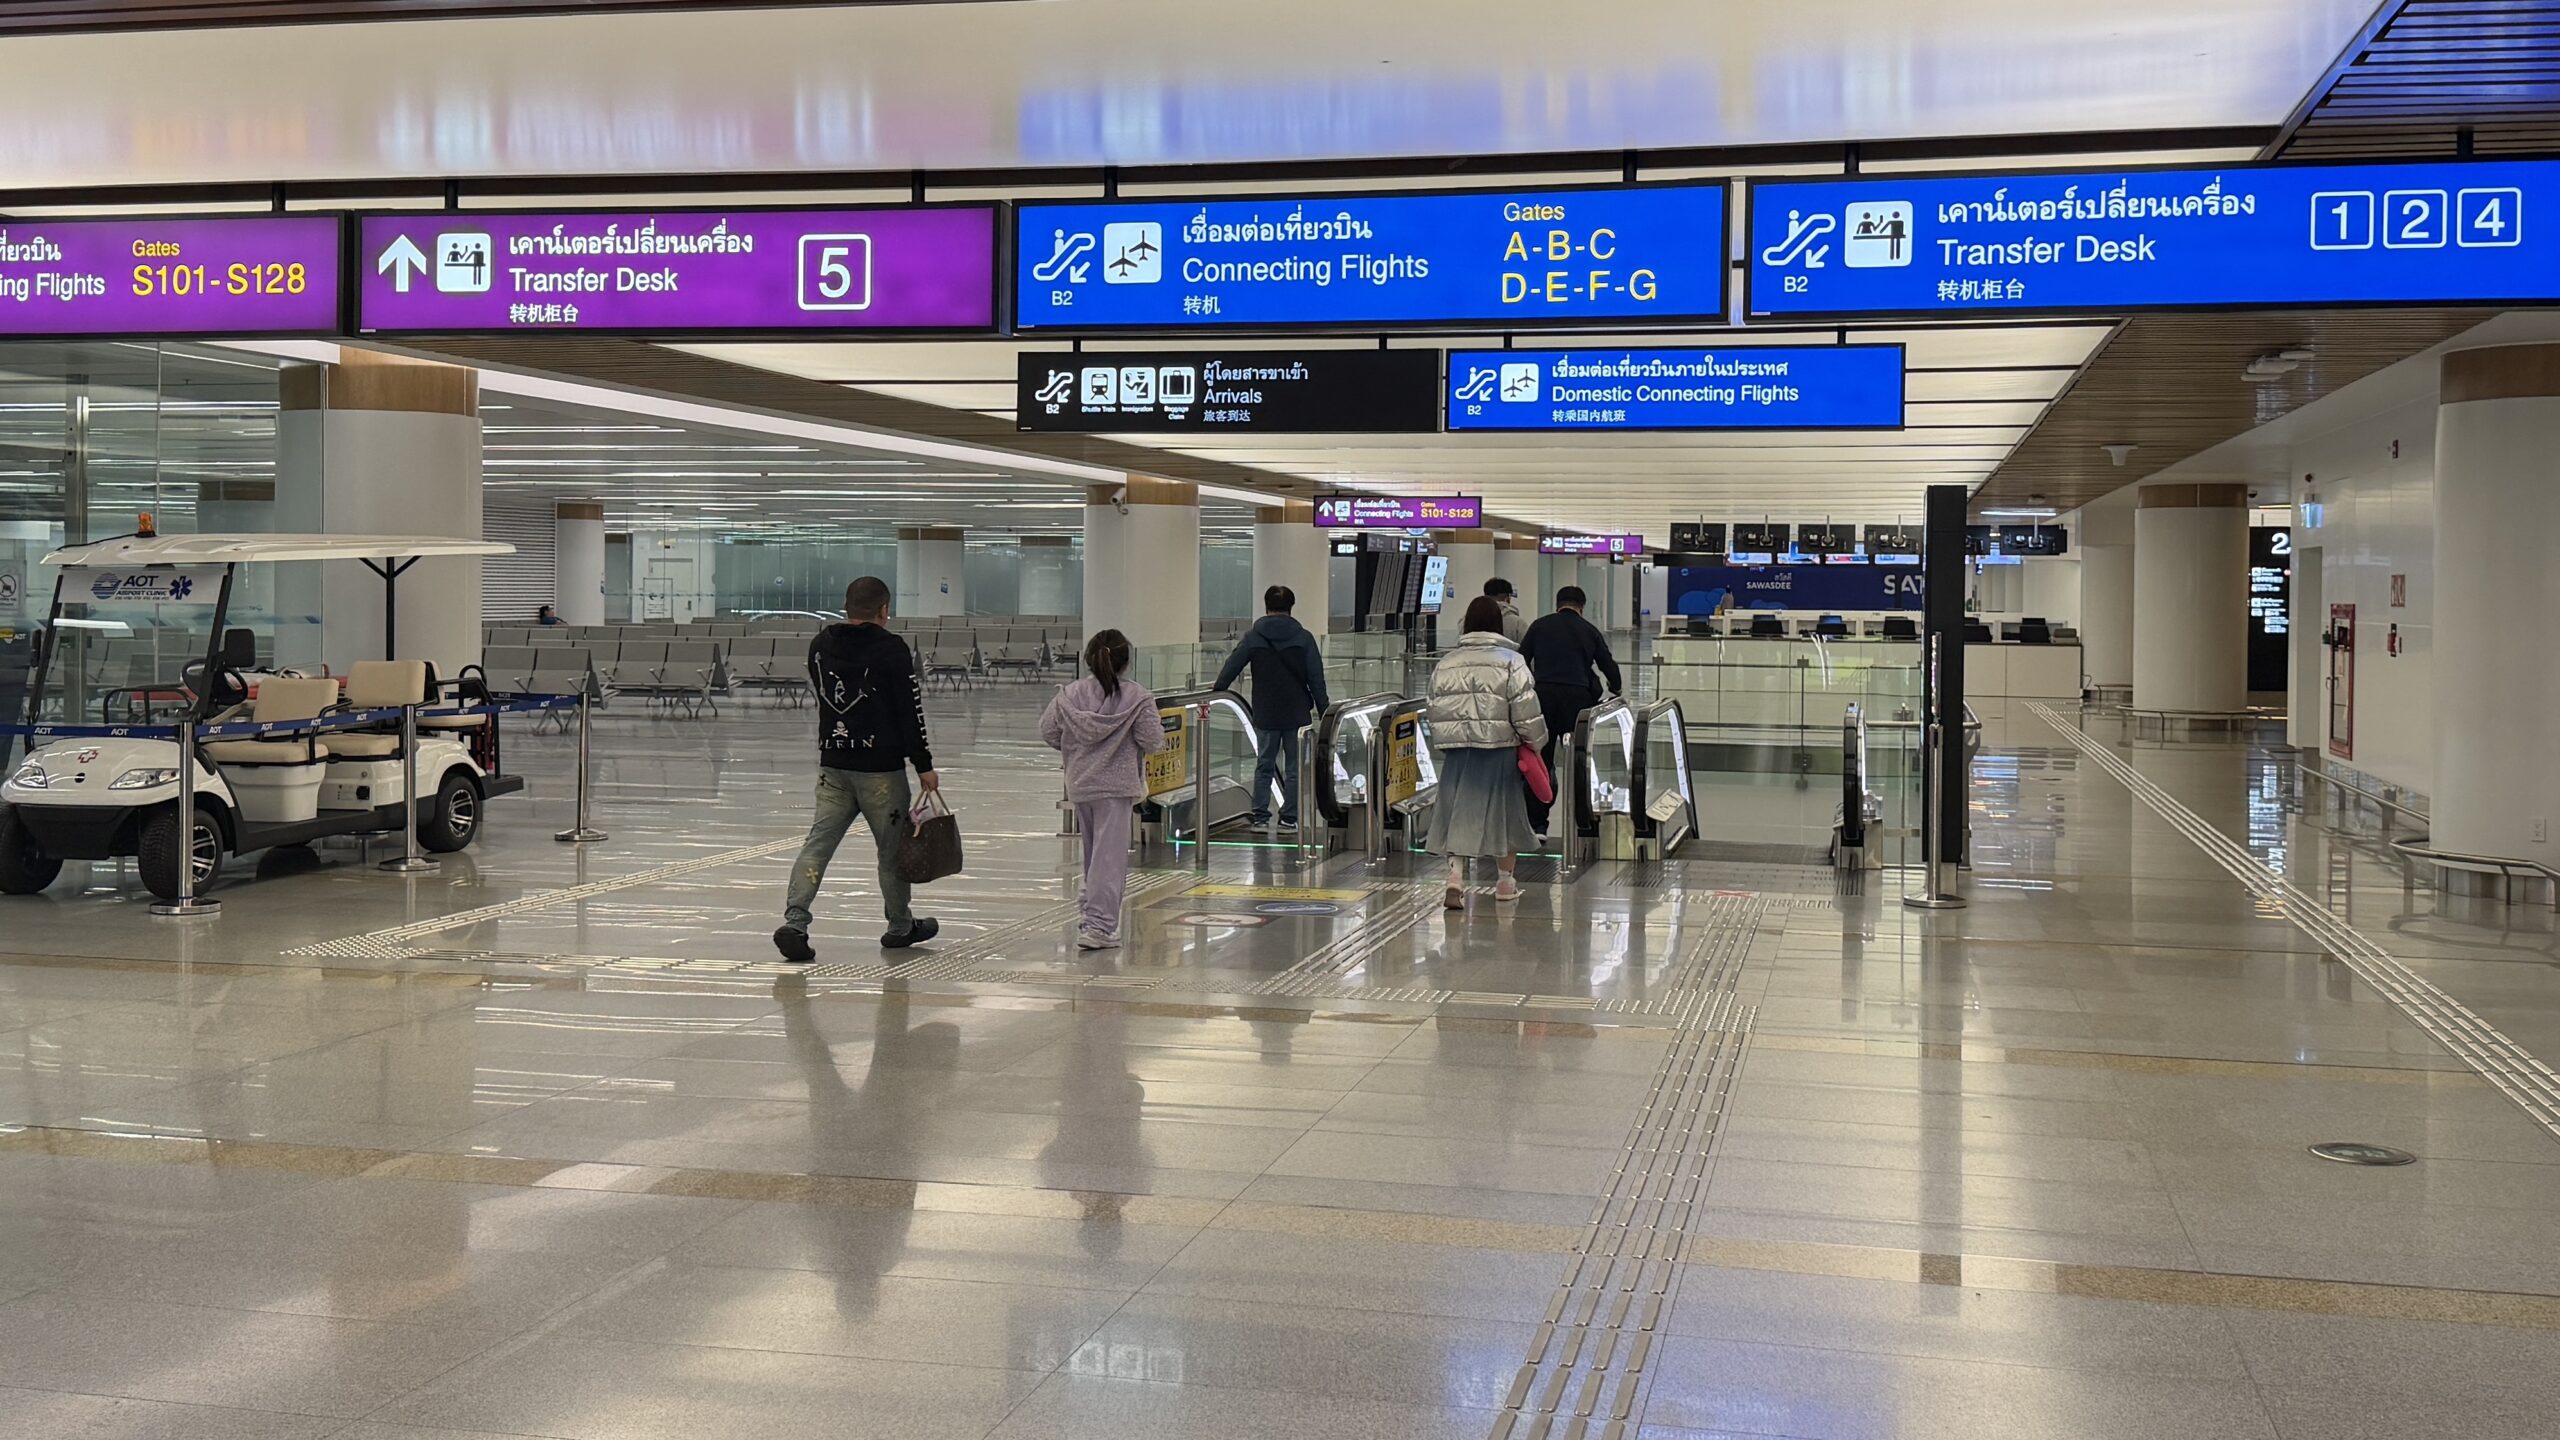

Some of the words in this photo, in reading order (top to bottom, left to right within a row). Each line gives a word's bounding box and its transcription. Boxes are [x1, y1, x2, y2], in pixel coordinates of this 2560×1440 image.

[1938, 177, 2256, 224] เคาน์เตอร์เปลี่ยนเครื่อง
[1503, 202, 1565, 222] Gates
[2331, 201, 2348, 240] 1
[2401, 199, 2430, 239] 2
[2474, 197, 2507, 237] 4
[1183, 205, 1373, 244] เชื่อมต่อเที่ยวบิน
[509, 217, 753, 255] เคาน์เตอร์เปลี่ยนเครื่อง
[132, 239, 181, 257] Gates
[1937, 236, 2066, 266] Transfer
[2076, 233, 2156, 263] Desk
[508, 267, 609, 293] Transfer
[616, 267, 678, 292] Desk
[818, 247, 851, 298] 5
[1182, 255, 1331, 287] Connecting
[1341, 253, 1429, 286] Flights
[36, 272, 106, 302] Flights
[1784, 275, 1809, 293] B2
[1937, 278, 2026, 302] 转机柜台
[1051, 290, 1073, 306] B2
[1183, 294, 1221, 315] 转机
[509, 303, 579, 323] 转机柜台
[1203, 361, 1309, 387] ผู้โดยสารขาเข้า
[1203, 387, 1263, 404] Arrivals
[1552, 385, 1632, 402] Domestic
[1636, 384, 1735, 406] Connecting
[1741, 384, 1800, 405] Flights
[1045, 403, 1060, 415] B2
[1467, 404, 1482, 416] B2
[123, 575, 159, 588] AOT
[1746, 581, 1792, 590] SAWASDEE
[260, 722, 274, 732] AOT
[309, 718, 322, 727] AOT
[355, 713, 368, 722] AOT
[34, 727, 53, 735] AOT
[110, 728, 129, 736] AOT
[208, 725, 222, 735] AOT
